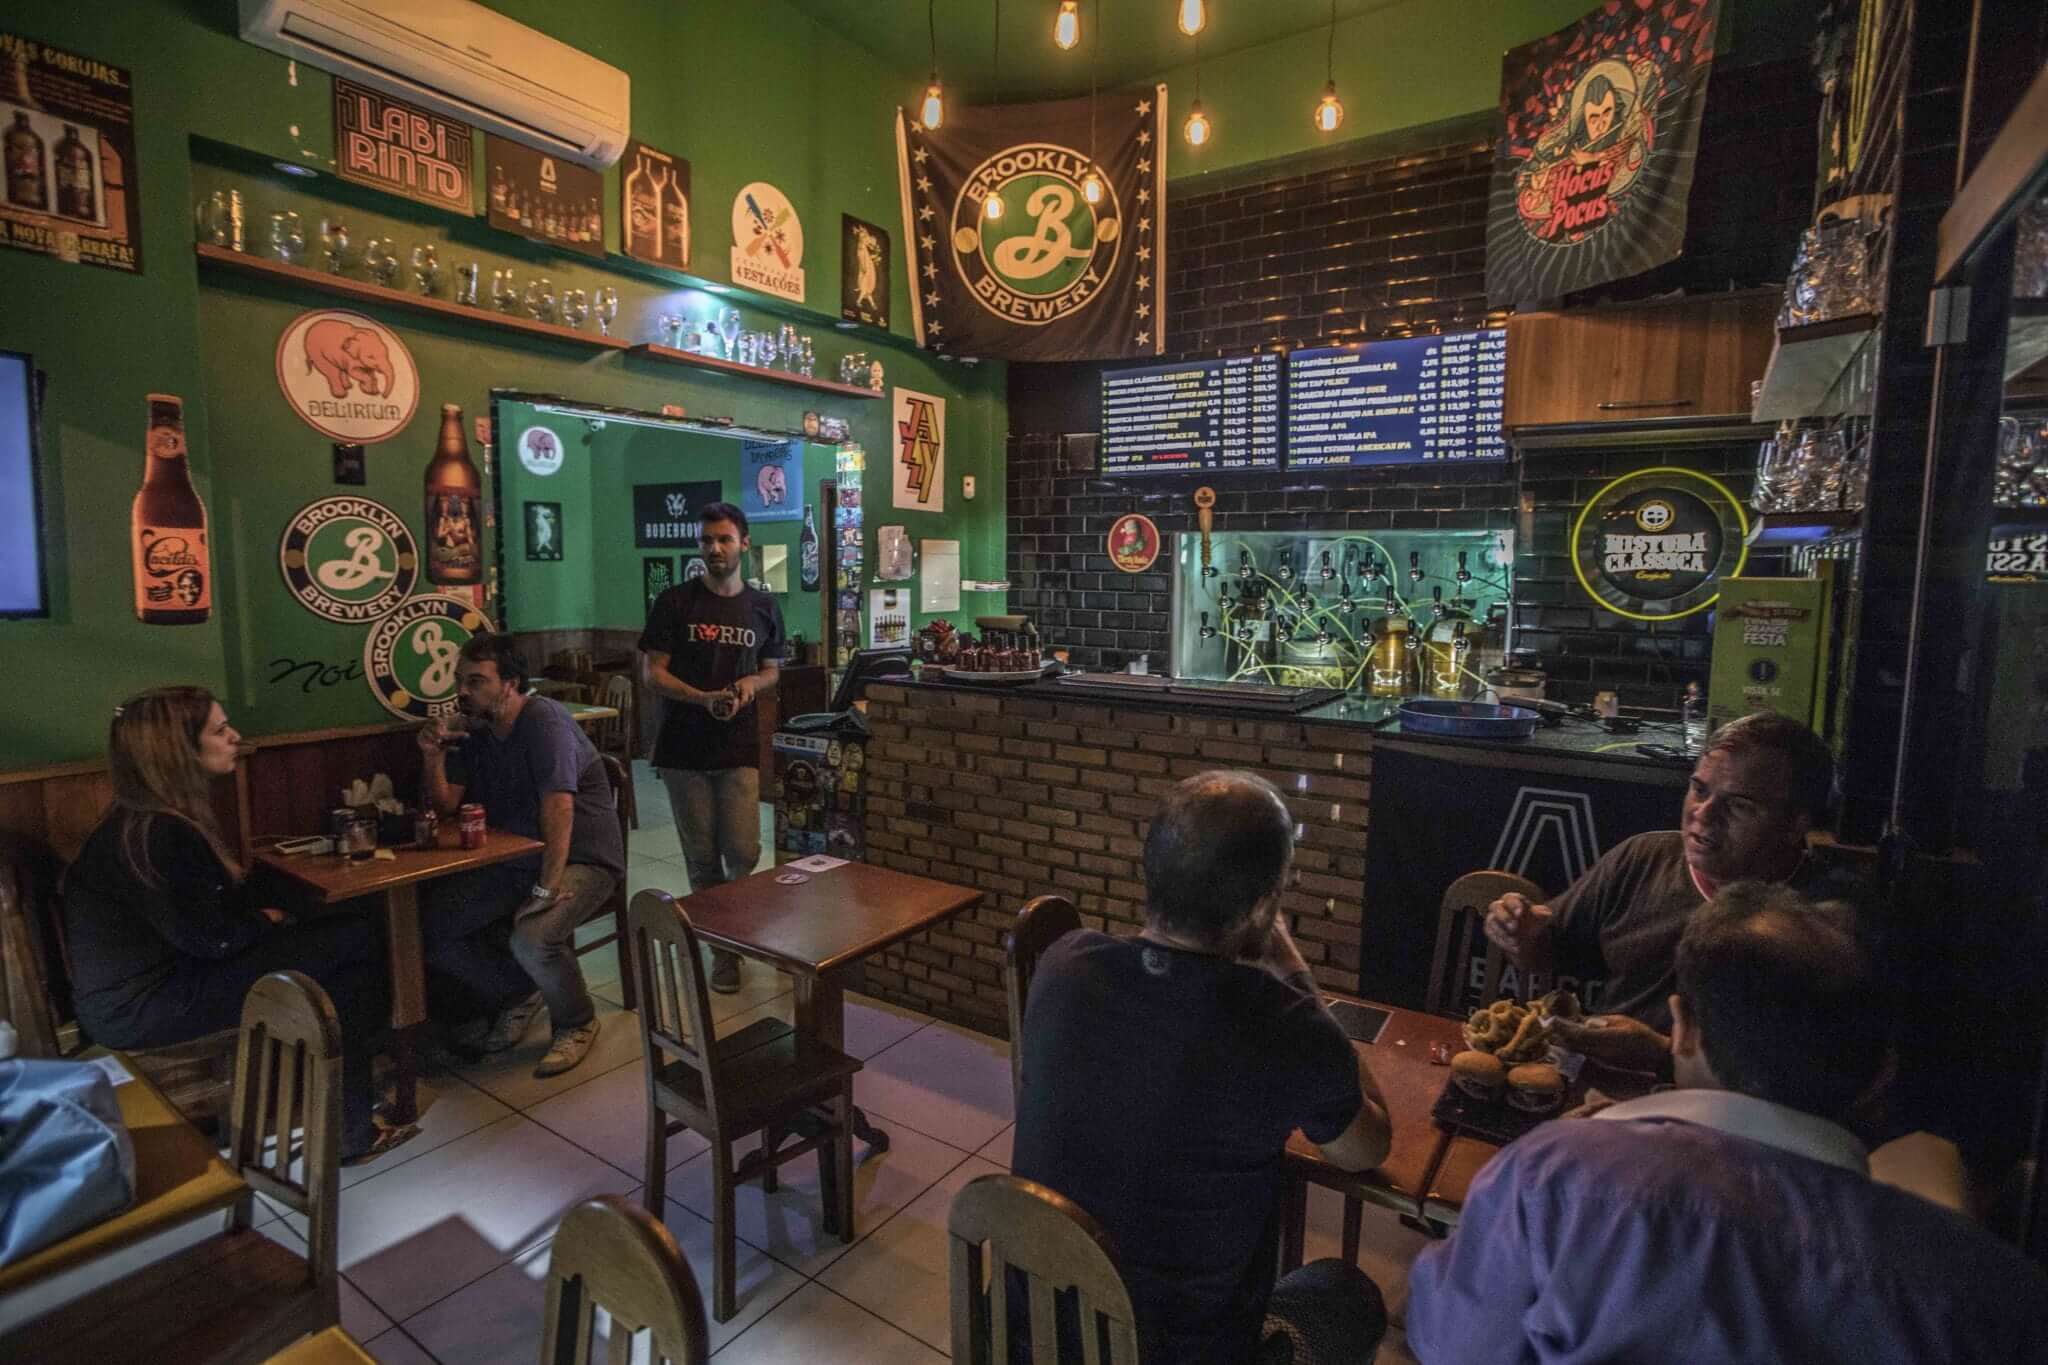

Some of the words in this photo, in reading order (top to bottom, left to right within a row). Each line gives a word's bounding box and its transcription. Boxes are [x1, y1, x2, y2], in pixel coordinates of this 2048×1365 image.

[359, 95, 448, 165] LABI
[349, 135, 463, 199] RINTO
[968, 150, 1090, 205] BROOKLY
[61, 234, 136, 263] GRRAFA!
[743, 267, 802, 296] ESTAÇÕES
[975, 267, 1102, 321] BREWERY
[307, 400, 403, 421] DELIRIUM
[298, 503, 404, 539] BROOKLYN
[301, 585, 406, 620] BREWERY
[374, 601, 449, 678] BROOKLYN
[719, 624, 757, 648] RIO
[1743, 633, 1789, 647] FESTA
